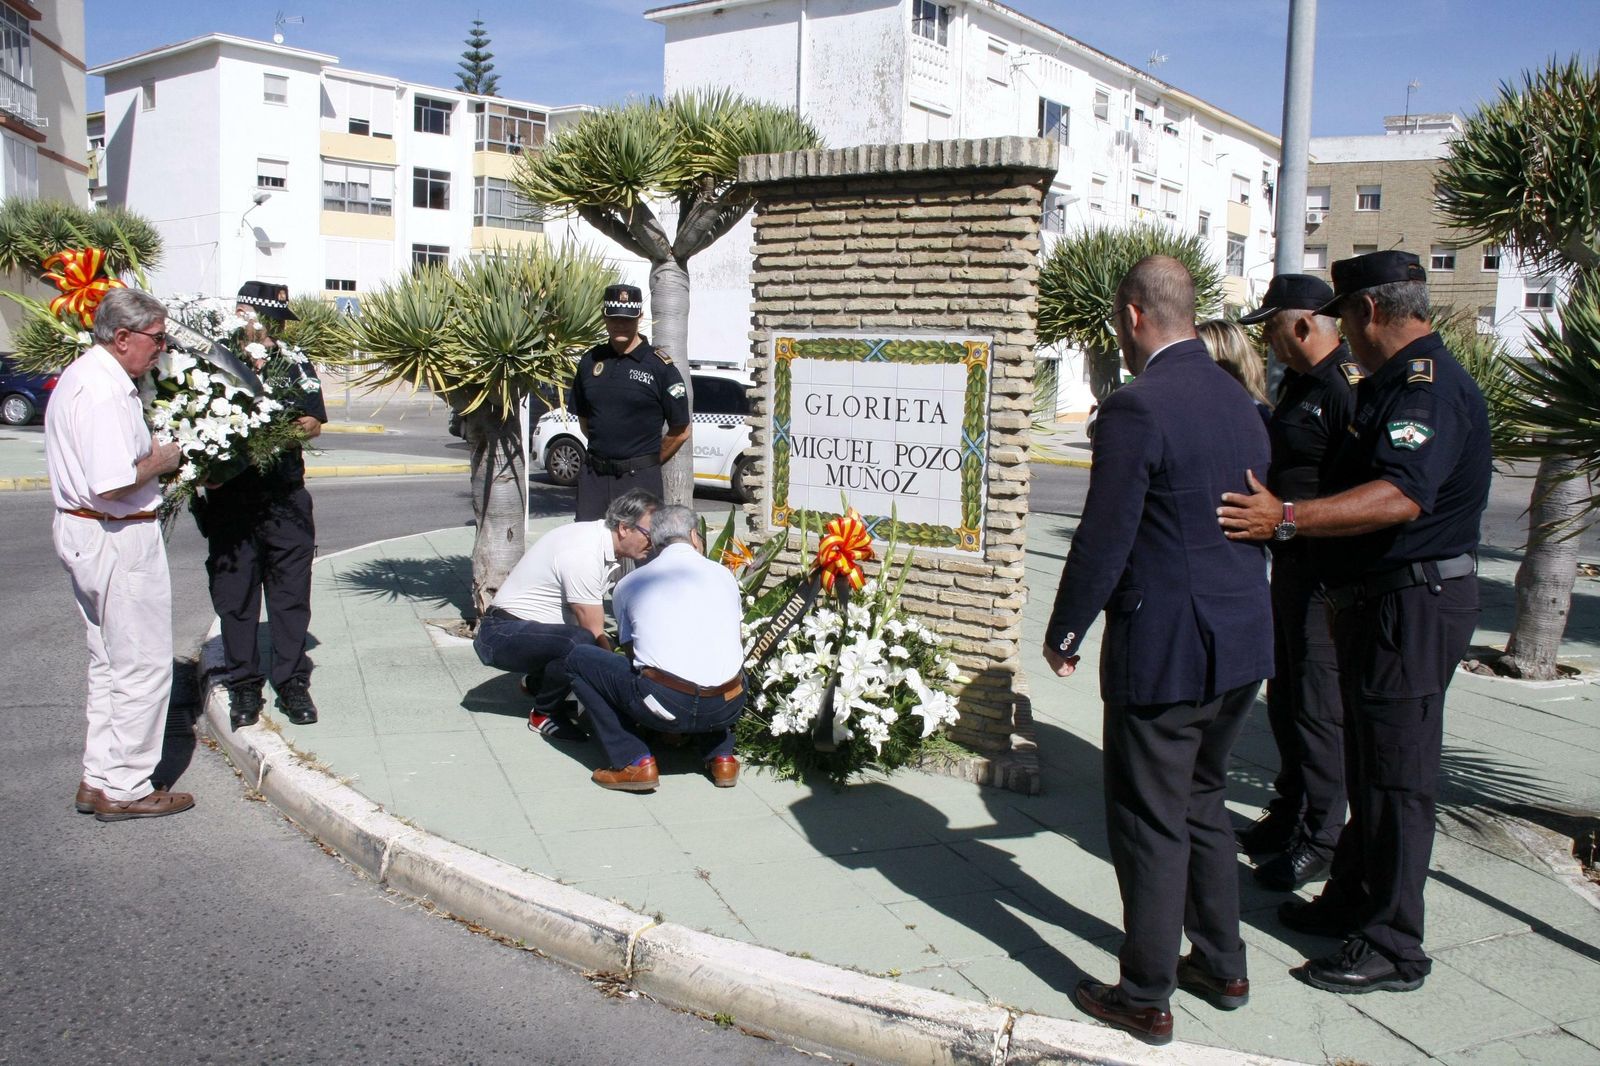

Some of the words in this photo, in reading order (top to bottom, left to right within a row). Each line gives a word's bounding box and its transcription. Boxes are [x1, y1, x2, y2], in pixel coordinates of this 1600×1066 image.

[630, 374, 651, 385] LOCAL
[804, 393, 948, 425] GLORIETA
[693, 445, 724, 457] OCAL
[790, 435, 880, 465] MIGUEL
[894, 443, 963, 472] POZO
[825, 463, 920, 496] MUÑOZ
